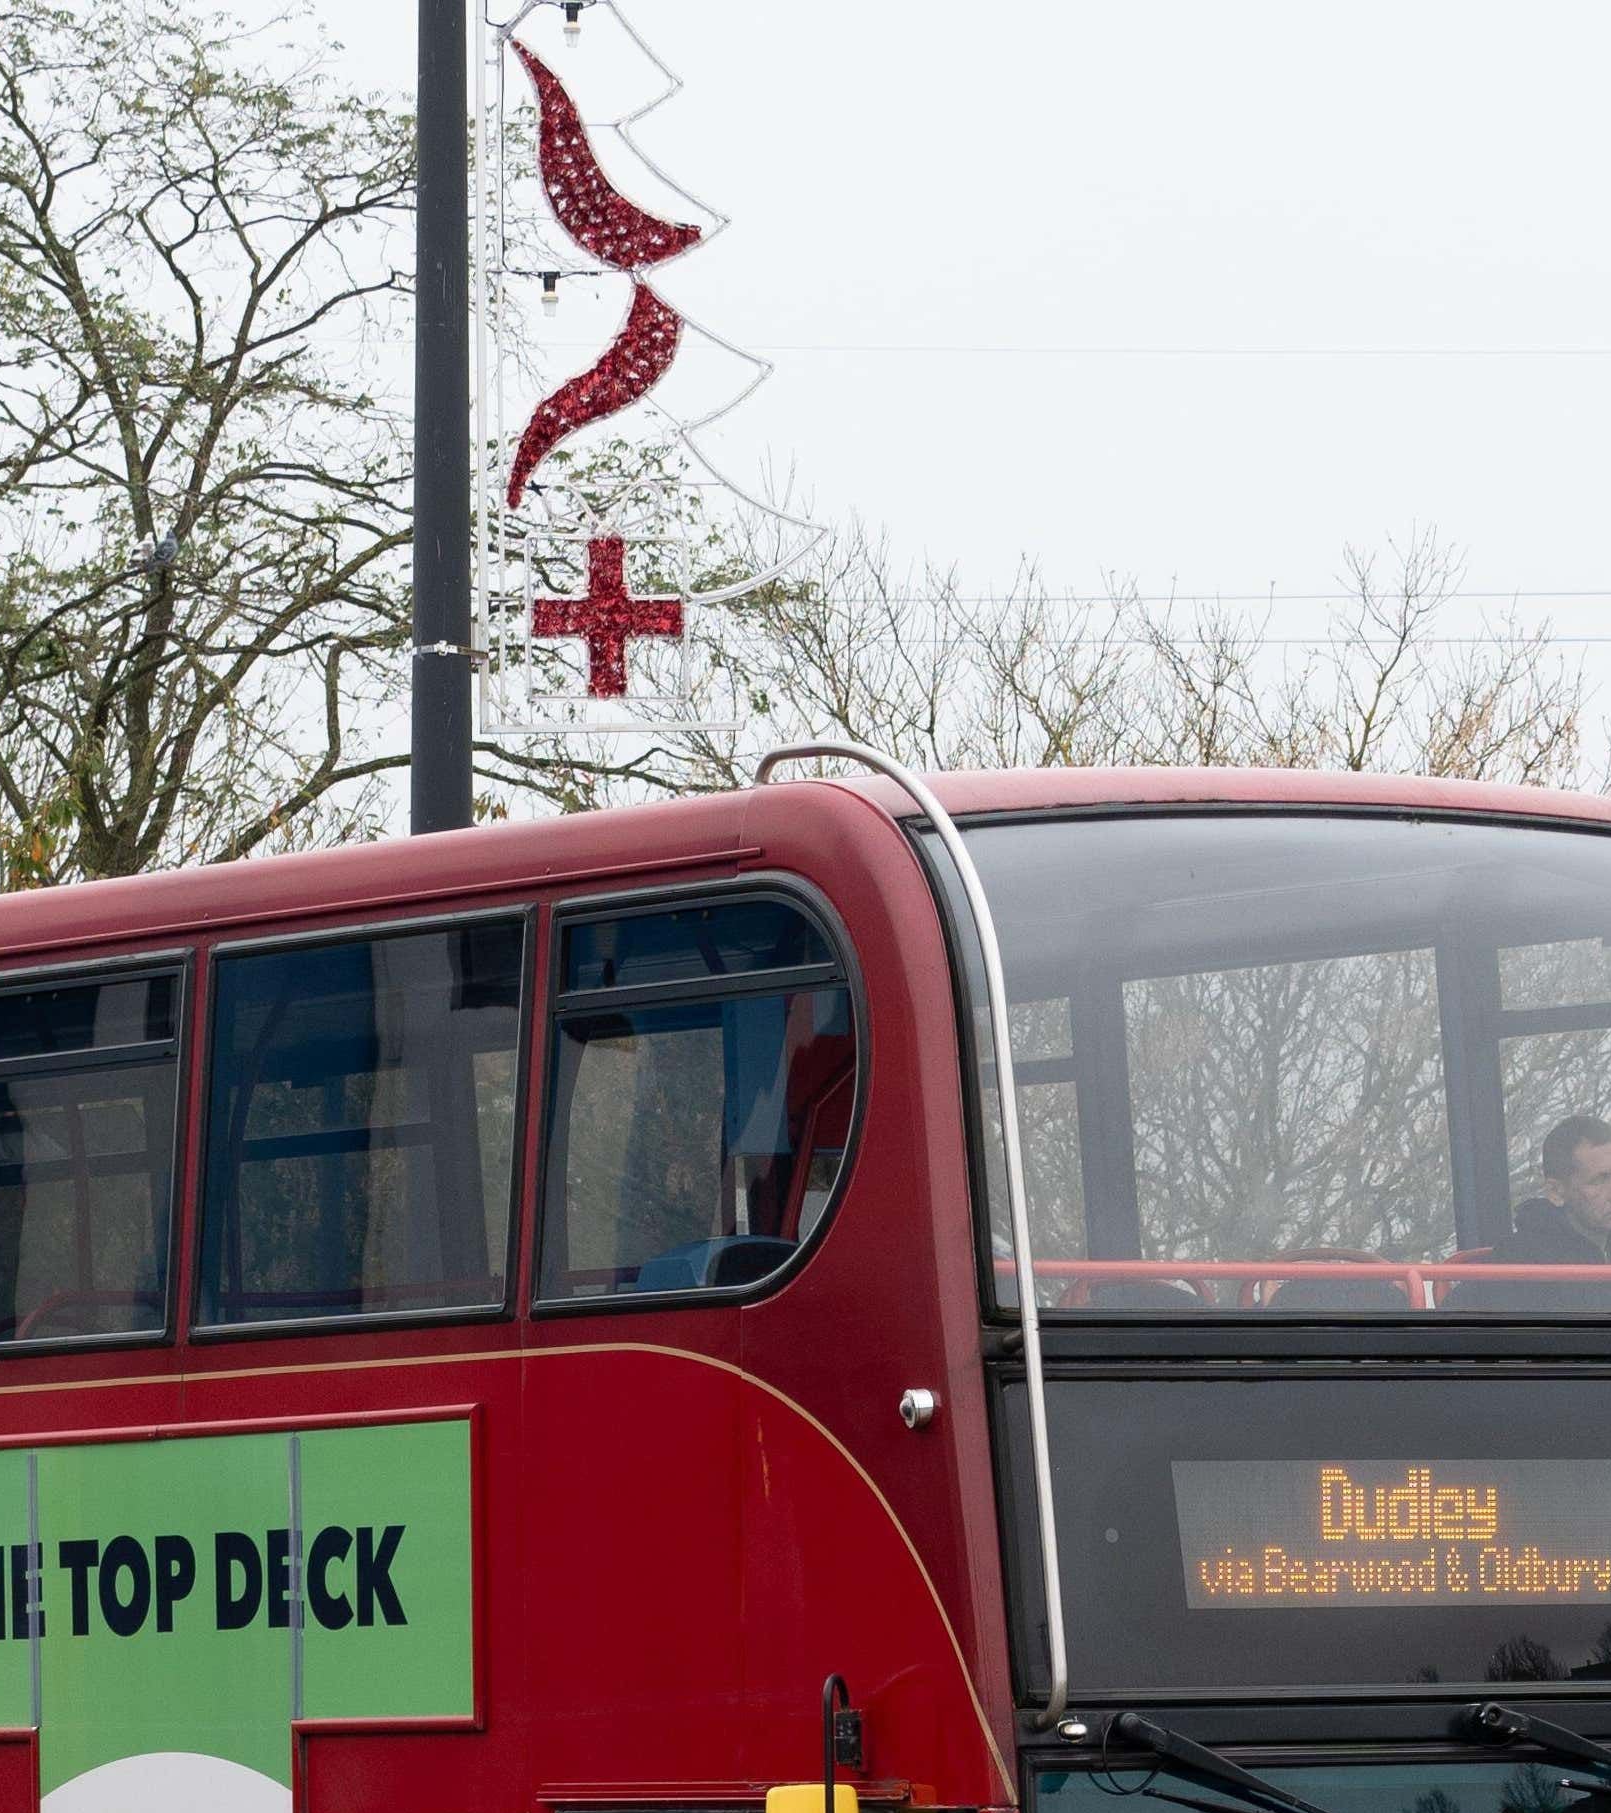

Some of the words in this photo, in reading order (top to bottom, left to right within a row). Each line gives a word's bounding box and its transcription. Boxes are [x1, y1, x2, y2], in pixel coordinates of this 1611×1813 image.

[1321, 1468, 1497, 1540] Dudley
[60, 1535, 196, 1637] TOP
[215, 1524, 407, 1631] DECK
[1199, 1547, 1253, 1593] via
[1263, 1546, 1436, 1592] Bearwood
[1445, 1547, 1468, 1592] &
[1478, 1546, 1611, 1592] Oldbury
